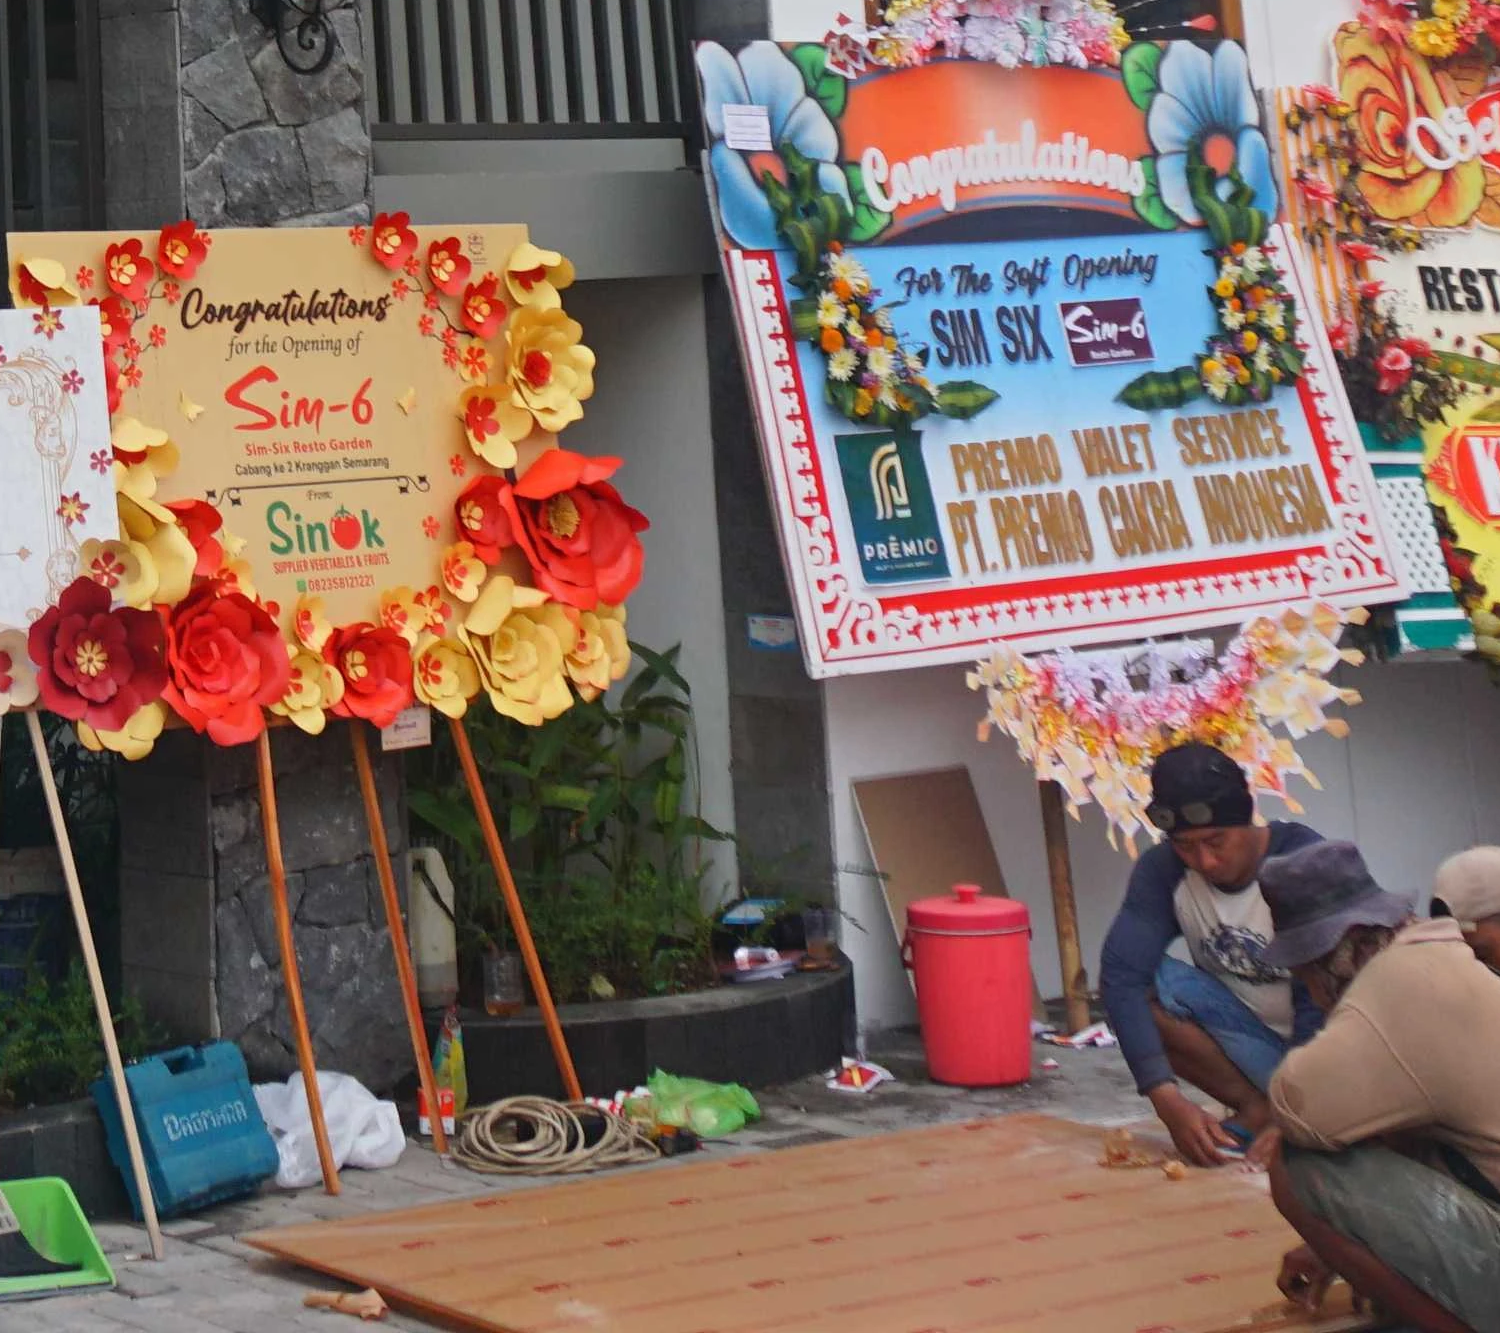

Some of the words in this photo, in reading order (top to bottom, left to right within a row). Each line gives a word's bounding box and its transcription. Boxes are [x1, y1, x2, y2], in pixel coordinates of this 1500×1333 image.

[861, 119, 1146, 212] Congratulations
[896, 265, 945, 298] For
[950, 263, 994, 297] The
[1002, 256, 1052, 298] Soft
[1062, 247, 1159, 291] Opening
[180, 287, 393, 334] Congratulations
[929, 307, 993, 368] SIM
[995, 304, 1054, 363] SIX
[1064, 305, 1146, 343] Sim-6
[225, 336, 251, 361] for
[255, 335, 278, 354] the
[282, 336, 342, 358] Opening
[346, 331, 364, 356] of
[224, 365, 374, 435] Sim-6
[235, 463, 272, 477] Cabang
[273, 462, 285, 474] ke
[296, 459, 341, 474] Kranggan
[342, 457, 390, 470] Semarang
[293, 441, 327, 454] Resto
[329, 437, 373, 451] Garden
[949, 433, 1063, 493] PREMIO
[1070, 423, 1157, 477] VALET
[1171, 408, 1291, 466] SERVICE
[1097, 479, 1193, 558] CAKRA
[1194, 463, 1335, 545] INDONESIA
